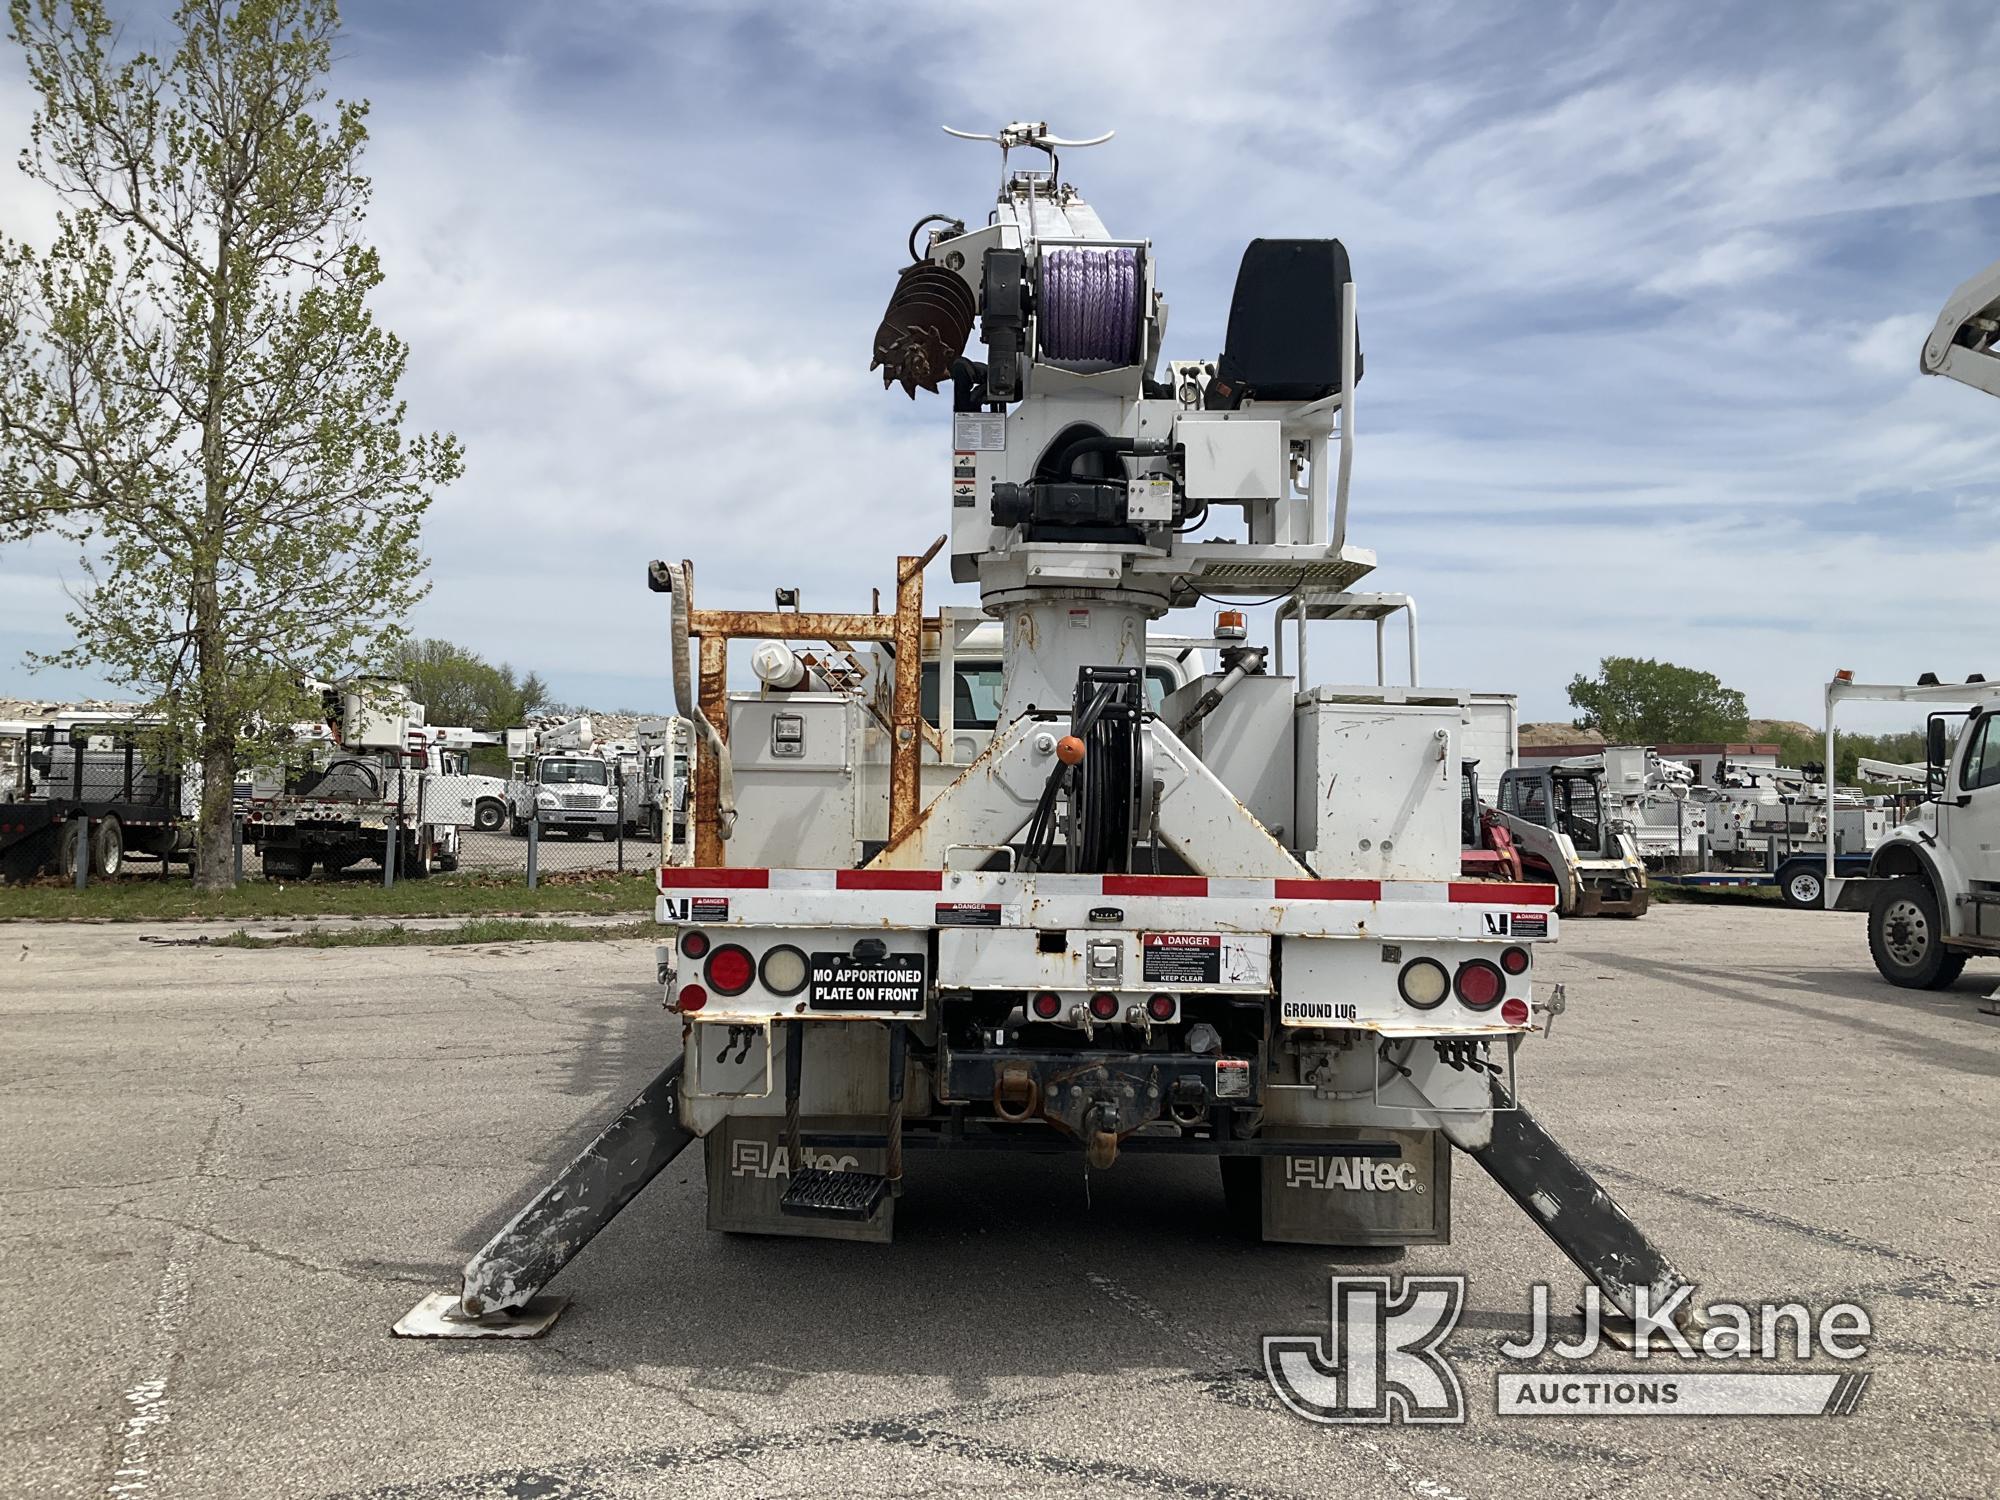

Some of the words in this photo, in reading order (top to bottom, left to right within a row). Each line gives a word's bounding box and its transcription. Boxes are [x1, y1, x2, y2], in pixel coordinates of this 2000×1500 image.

[1167, 936, 1210, 946] DANGER
[813, 969, 833, 982] MO
[835, 969, 922, 983] APPORTIONED
[815, 987, 854, 1000] PLATE
[856, 988, 875, 1000] ON
[877, 988, 919, 1001] FRONT
[1284, 1002, 1332, 1018] GROUND
[1335, 1003, 1357, 1019] LUG
